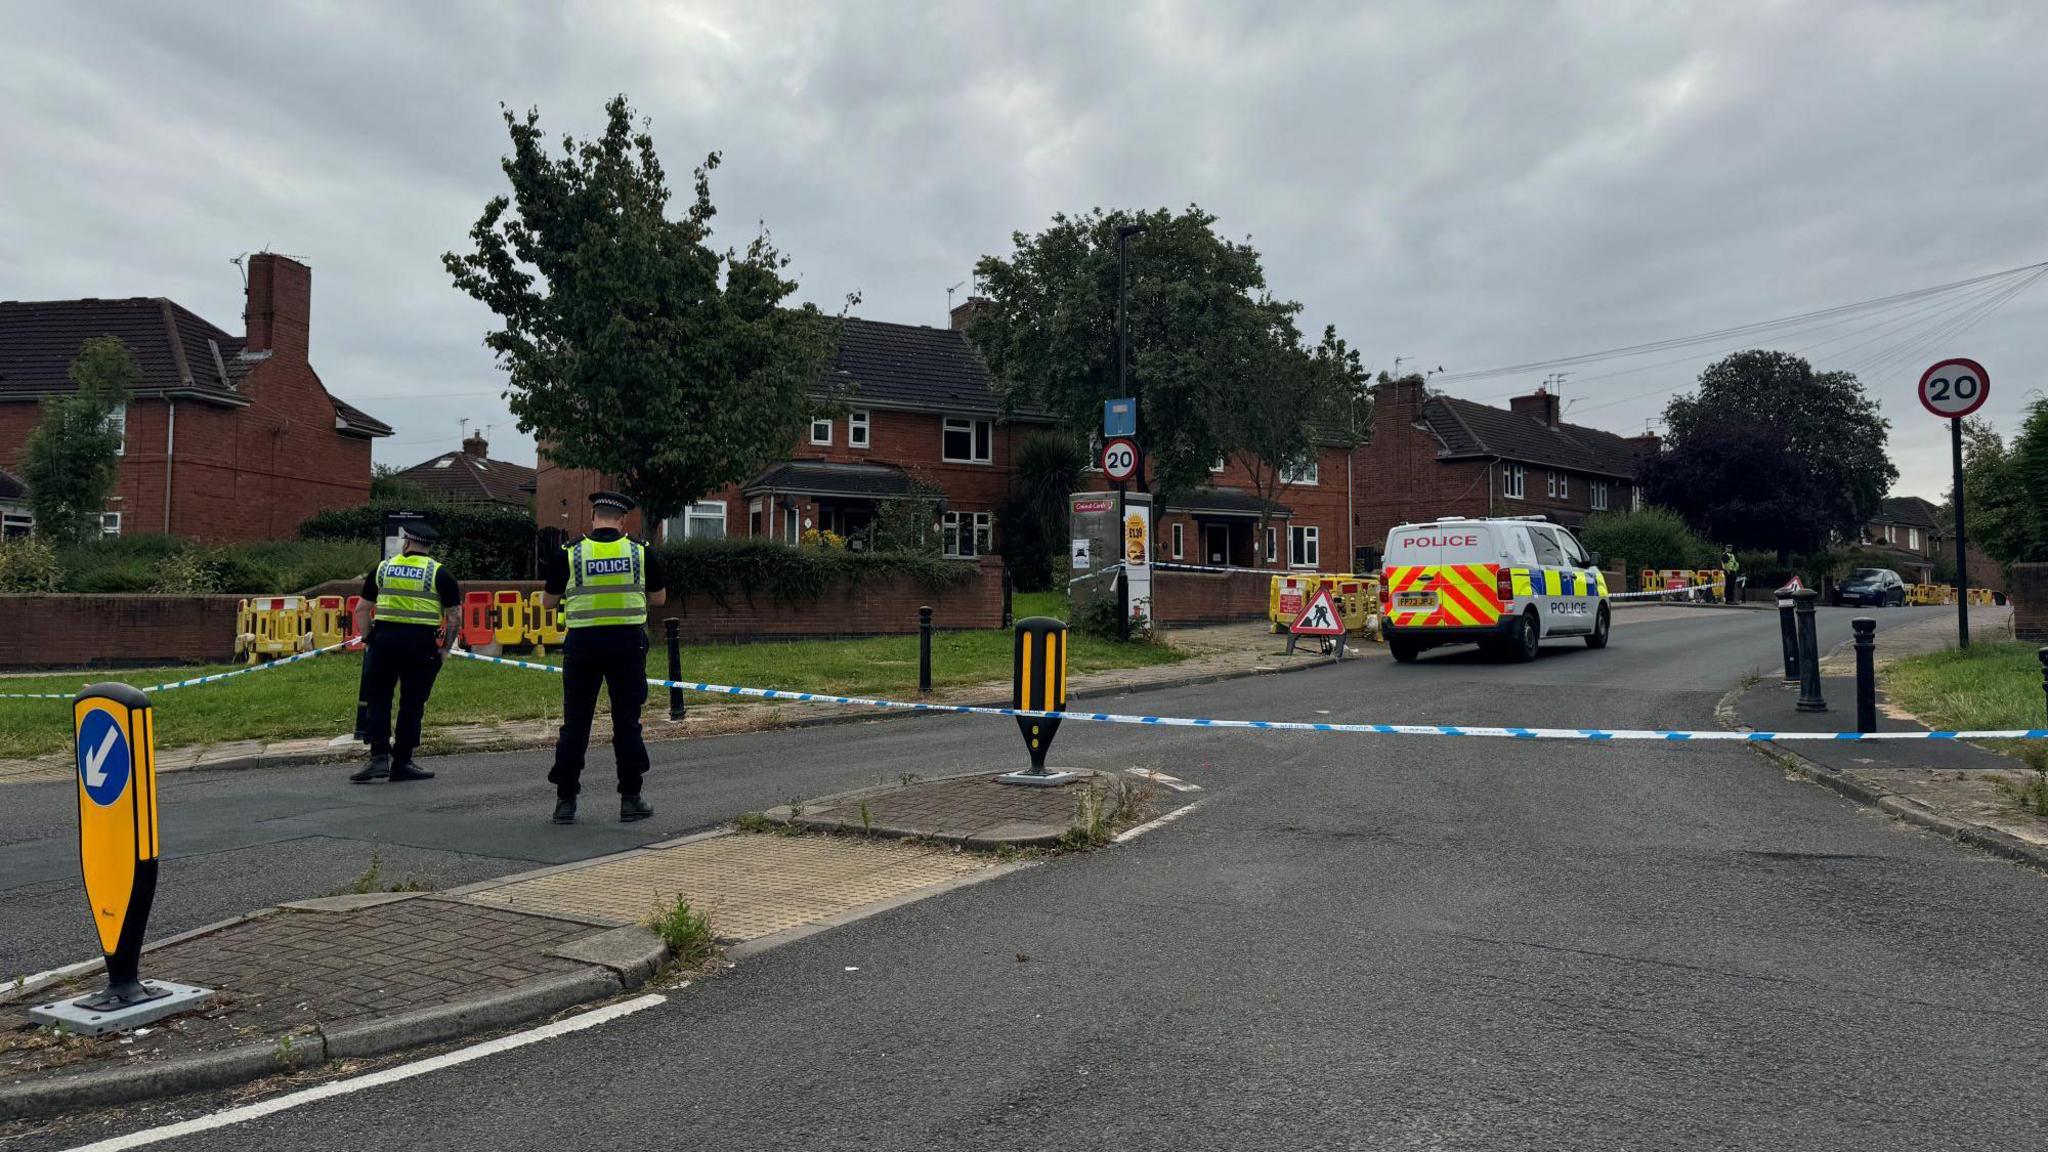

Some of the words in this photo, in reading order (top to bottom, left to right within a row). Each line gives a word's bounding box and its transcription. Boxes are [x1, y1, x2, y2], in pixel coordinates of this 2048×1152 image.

[1929, 375, 1977, 402] 20
[1107, 451, 1133, 468] 20
[1403, 535, 1478, 549] POLICE
[387, 566, 423, 578] POLICE
[587, 559, 630, 574] POLICE
[1550, 602, 1587, 614] POLICE
